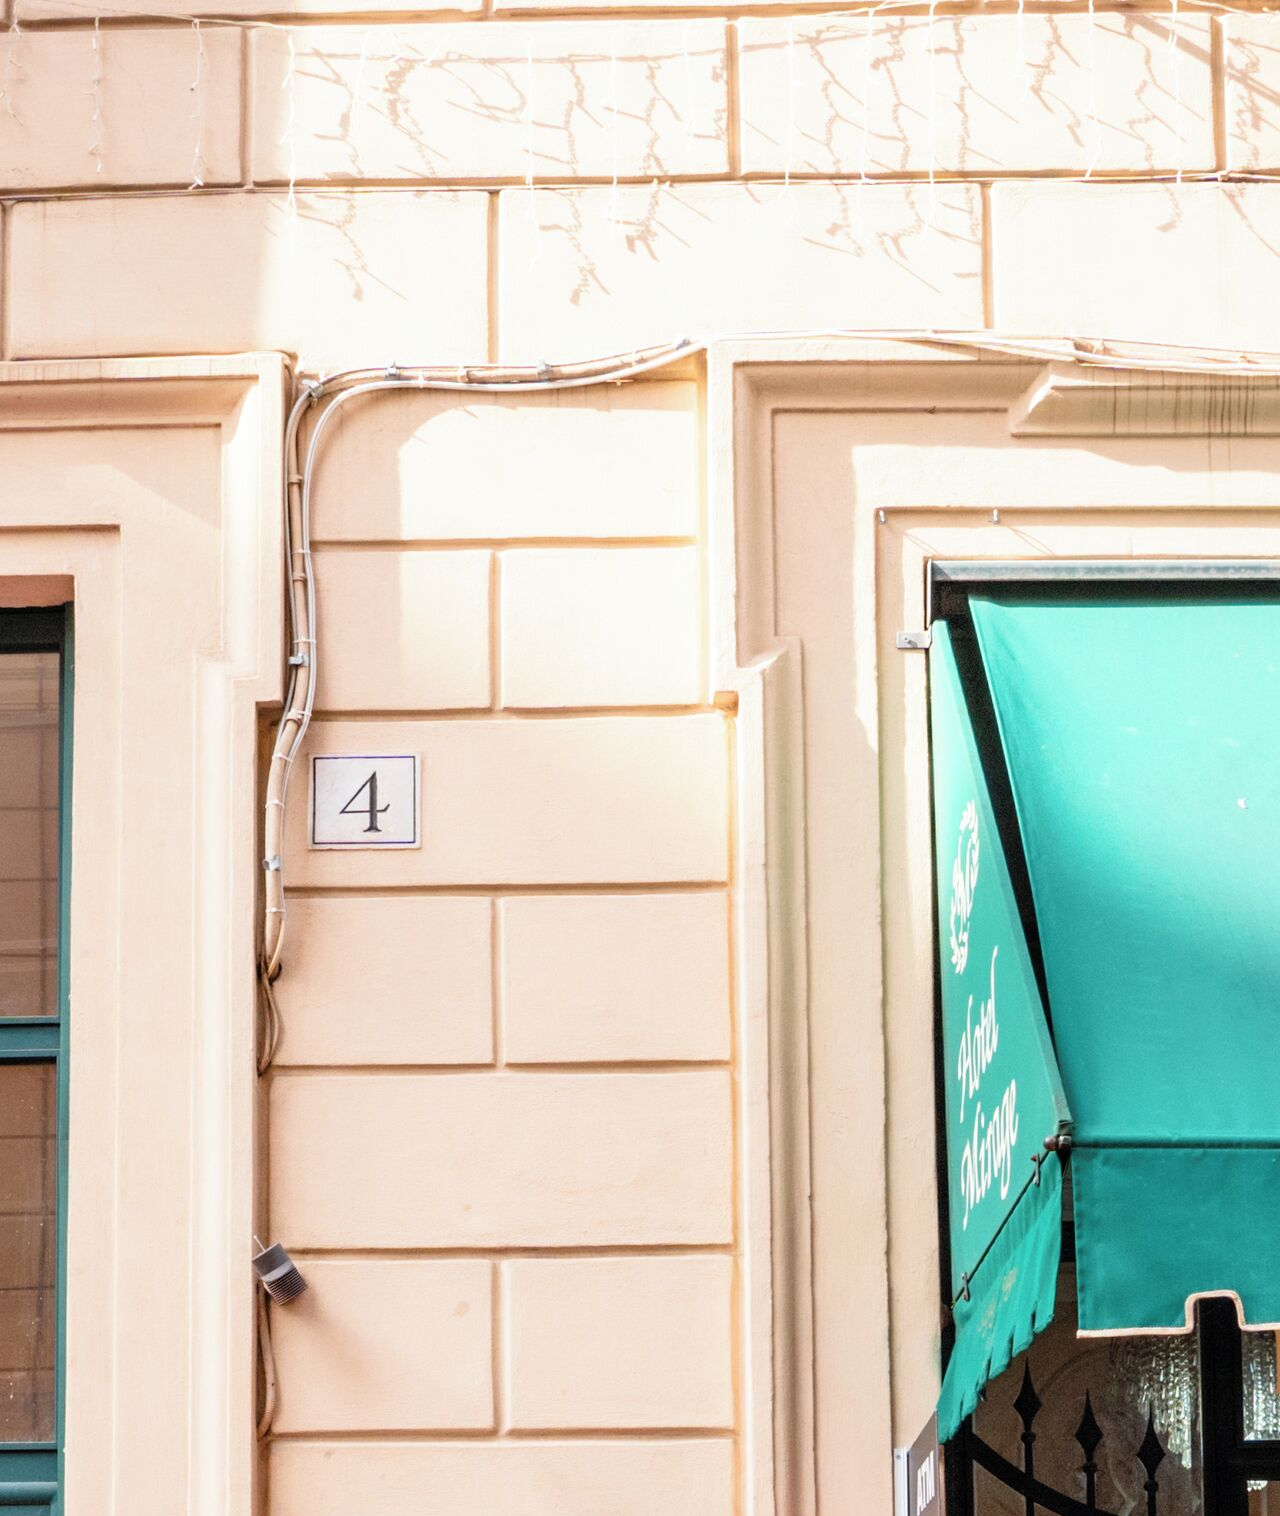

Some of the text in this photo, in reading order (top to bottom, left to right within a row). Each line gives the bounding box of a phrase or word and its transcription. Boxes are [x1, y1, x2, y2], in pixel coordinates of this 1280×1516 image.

[339, 770, 391, 833] 4
[958, 945, 999, 1123] Hotel
[961, 1078, 1019, 1231] Mirage
